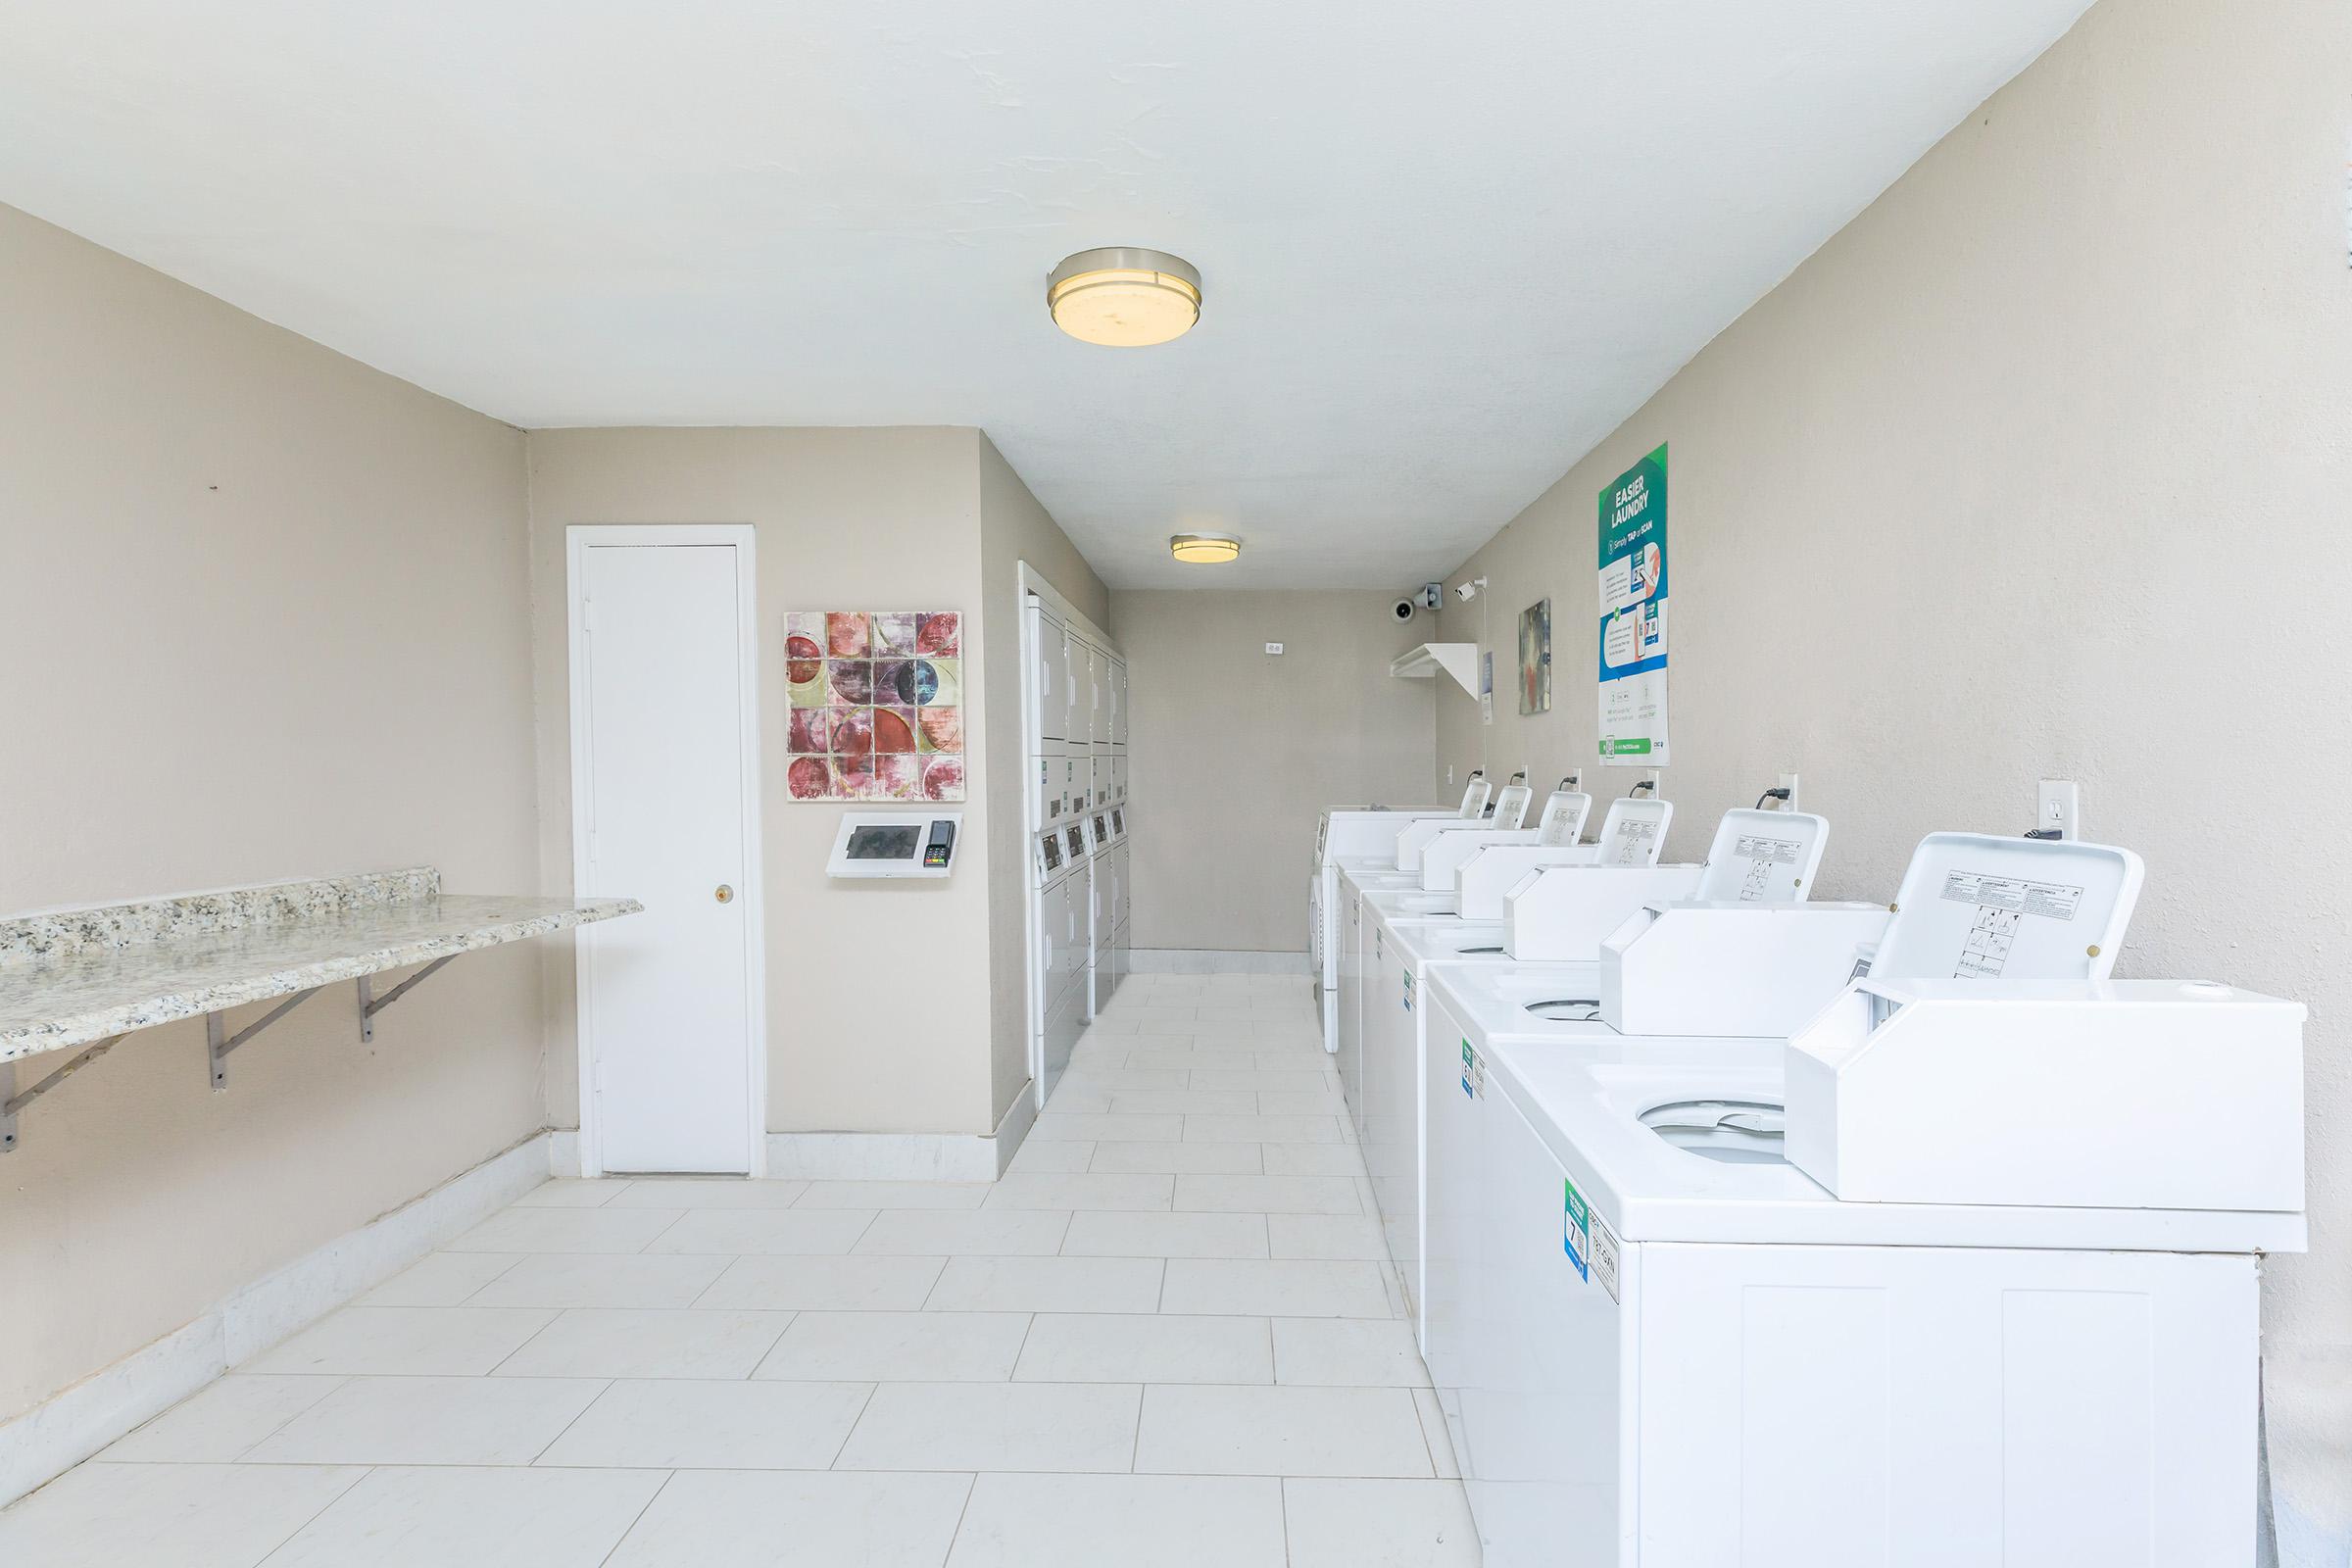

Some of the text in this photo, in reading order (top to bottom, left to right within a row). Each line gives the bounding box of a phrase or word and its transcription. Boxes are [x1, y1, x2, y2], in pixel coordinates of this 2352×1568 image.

[1615, 474, 1644, 508] EASIER
[1611, 490, 1649, 528] LAUNDRY
[1614, 536, 1627, 549] Simply
[1627, 530, 1637, 542] TAP
[1641, 519, 1653, 534] SCAN
[1570, 1220, 1576, 1242] 7
